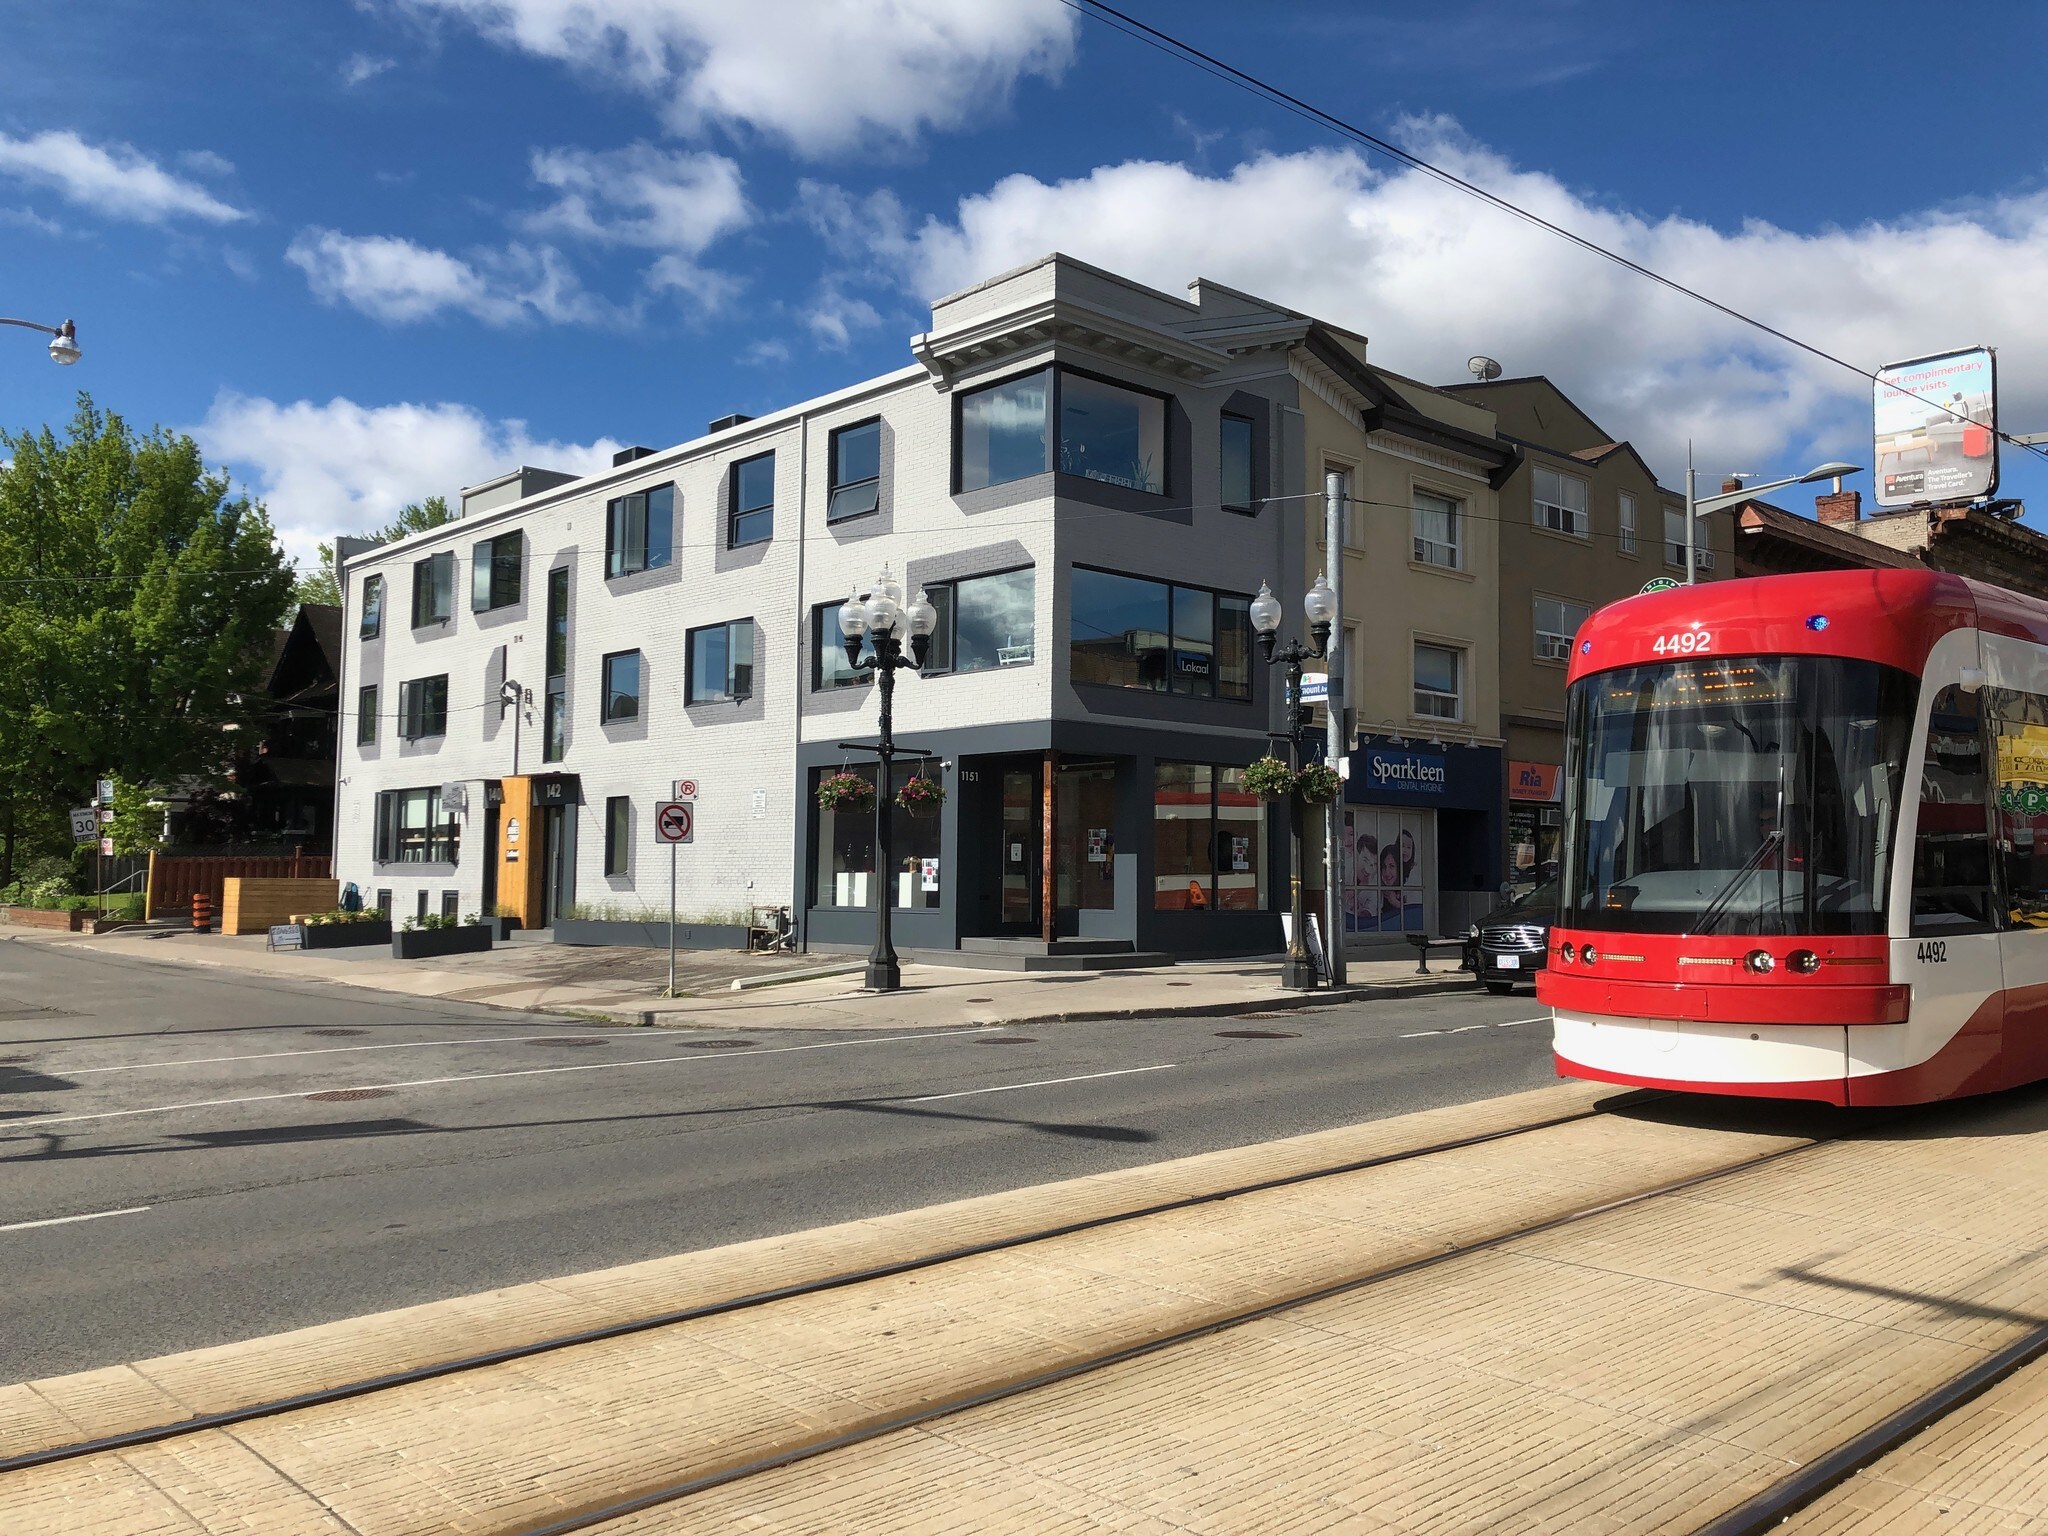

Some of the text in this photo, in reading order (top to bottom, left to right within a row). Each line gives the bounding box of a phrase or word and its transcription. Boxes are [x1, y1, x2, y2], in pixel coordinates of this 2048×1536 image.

[1884, 362, 1983, 386] Get complimentary
[1928, 482, 1947, 491] Travel
[1653, 631, 1711, 655] 4492
[1181, 660, 1209, 674] Lokaal
[961, 770, 979, 782] 1151
[1373, 755, 1445, 784] Sparkleen
[1397, 780, 1419, 791] DENTAL
[1520, 769, 1542, 787] Ria
[546, 783, 561, 798] 142
[76, 820, 94, 833] 30
[1917, 941, 1948, 964] 4492
